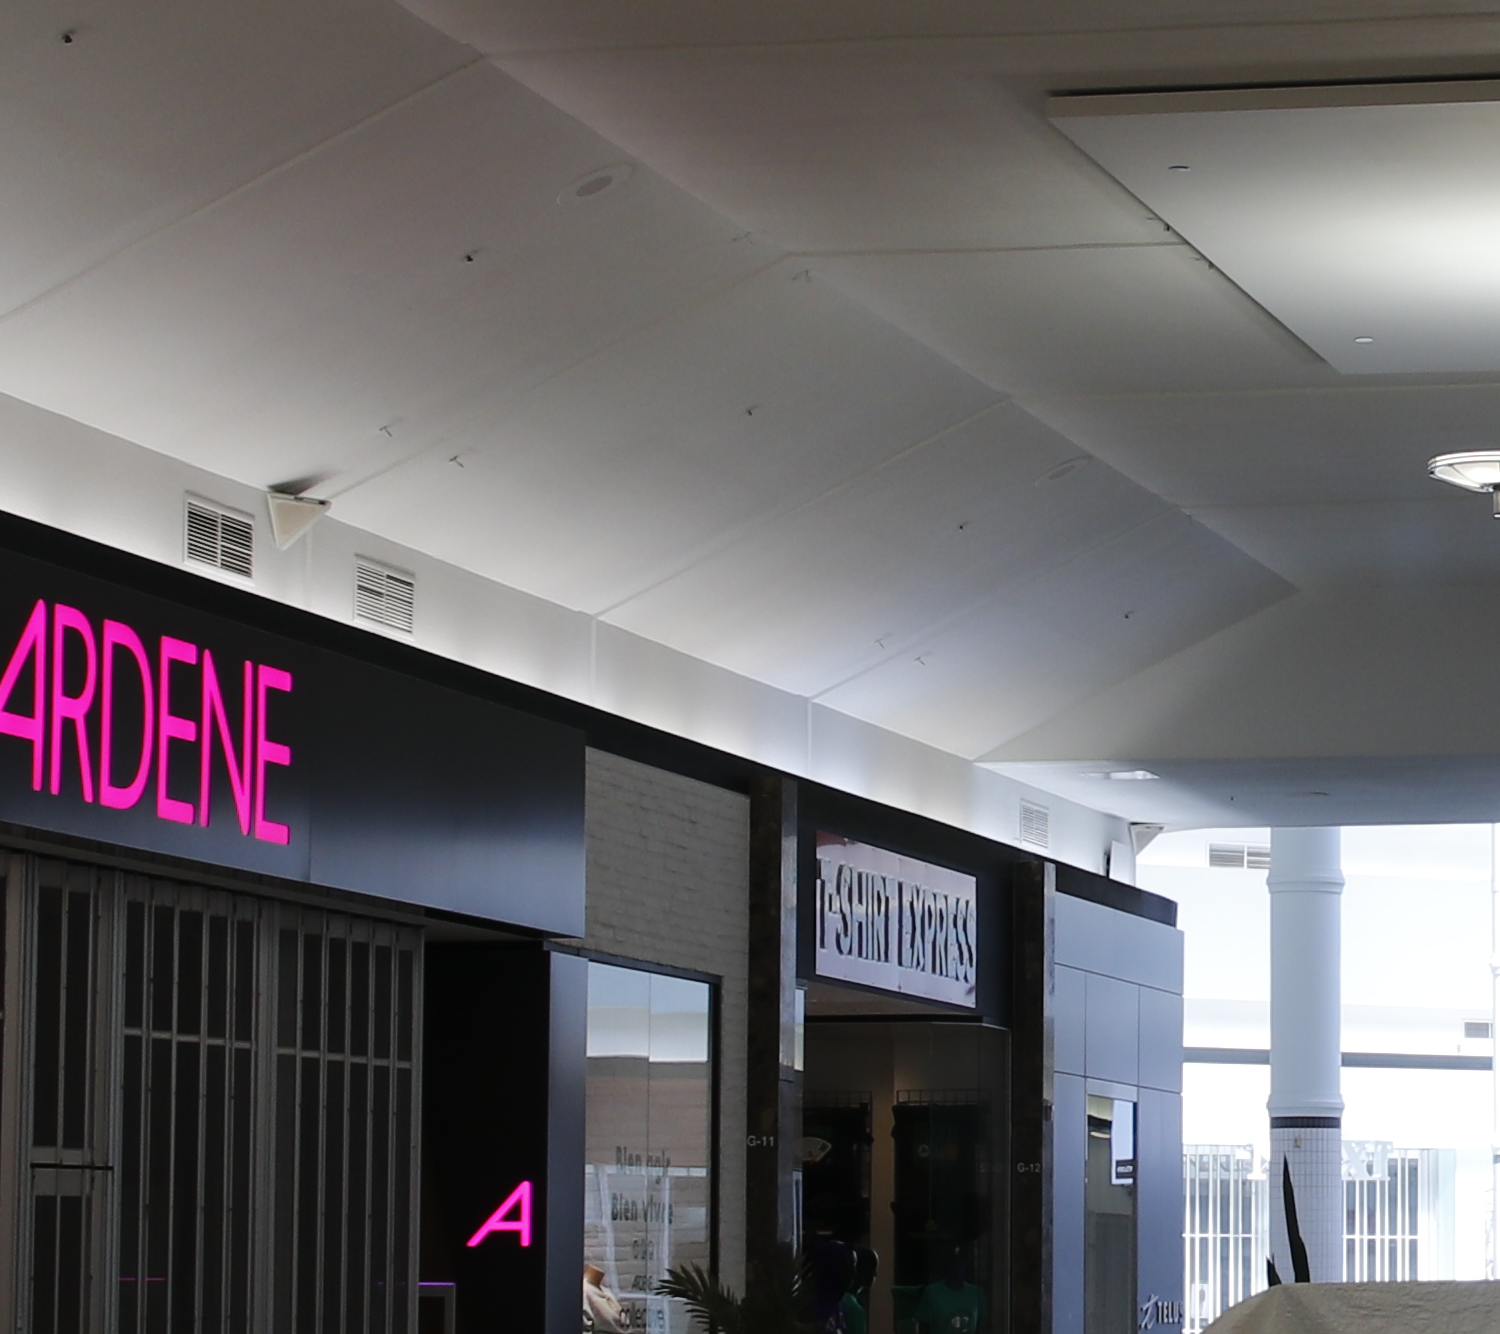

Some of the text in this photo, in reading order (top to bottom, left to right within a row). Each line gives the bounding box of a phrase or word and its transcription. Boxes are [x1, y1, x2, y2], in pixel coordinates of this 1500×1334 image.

[816, 858, 977, 988] T-SHIRT EXPRESS
[747, 1135, 775, 1147] G-11
[1017, 1162, 1041, 1173] G-12
[467, 1180, 533, 1247] A
